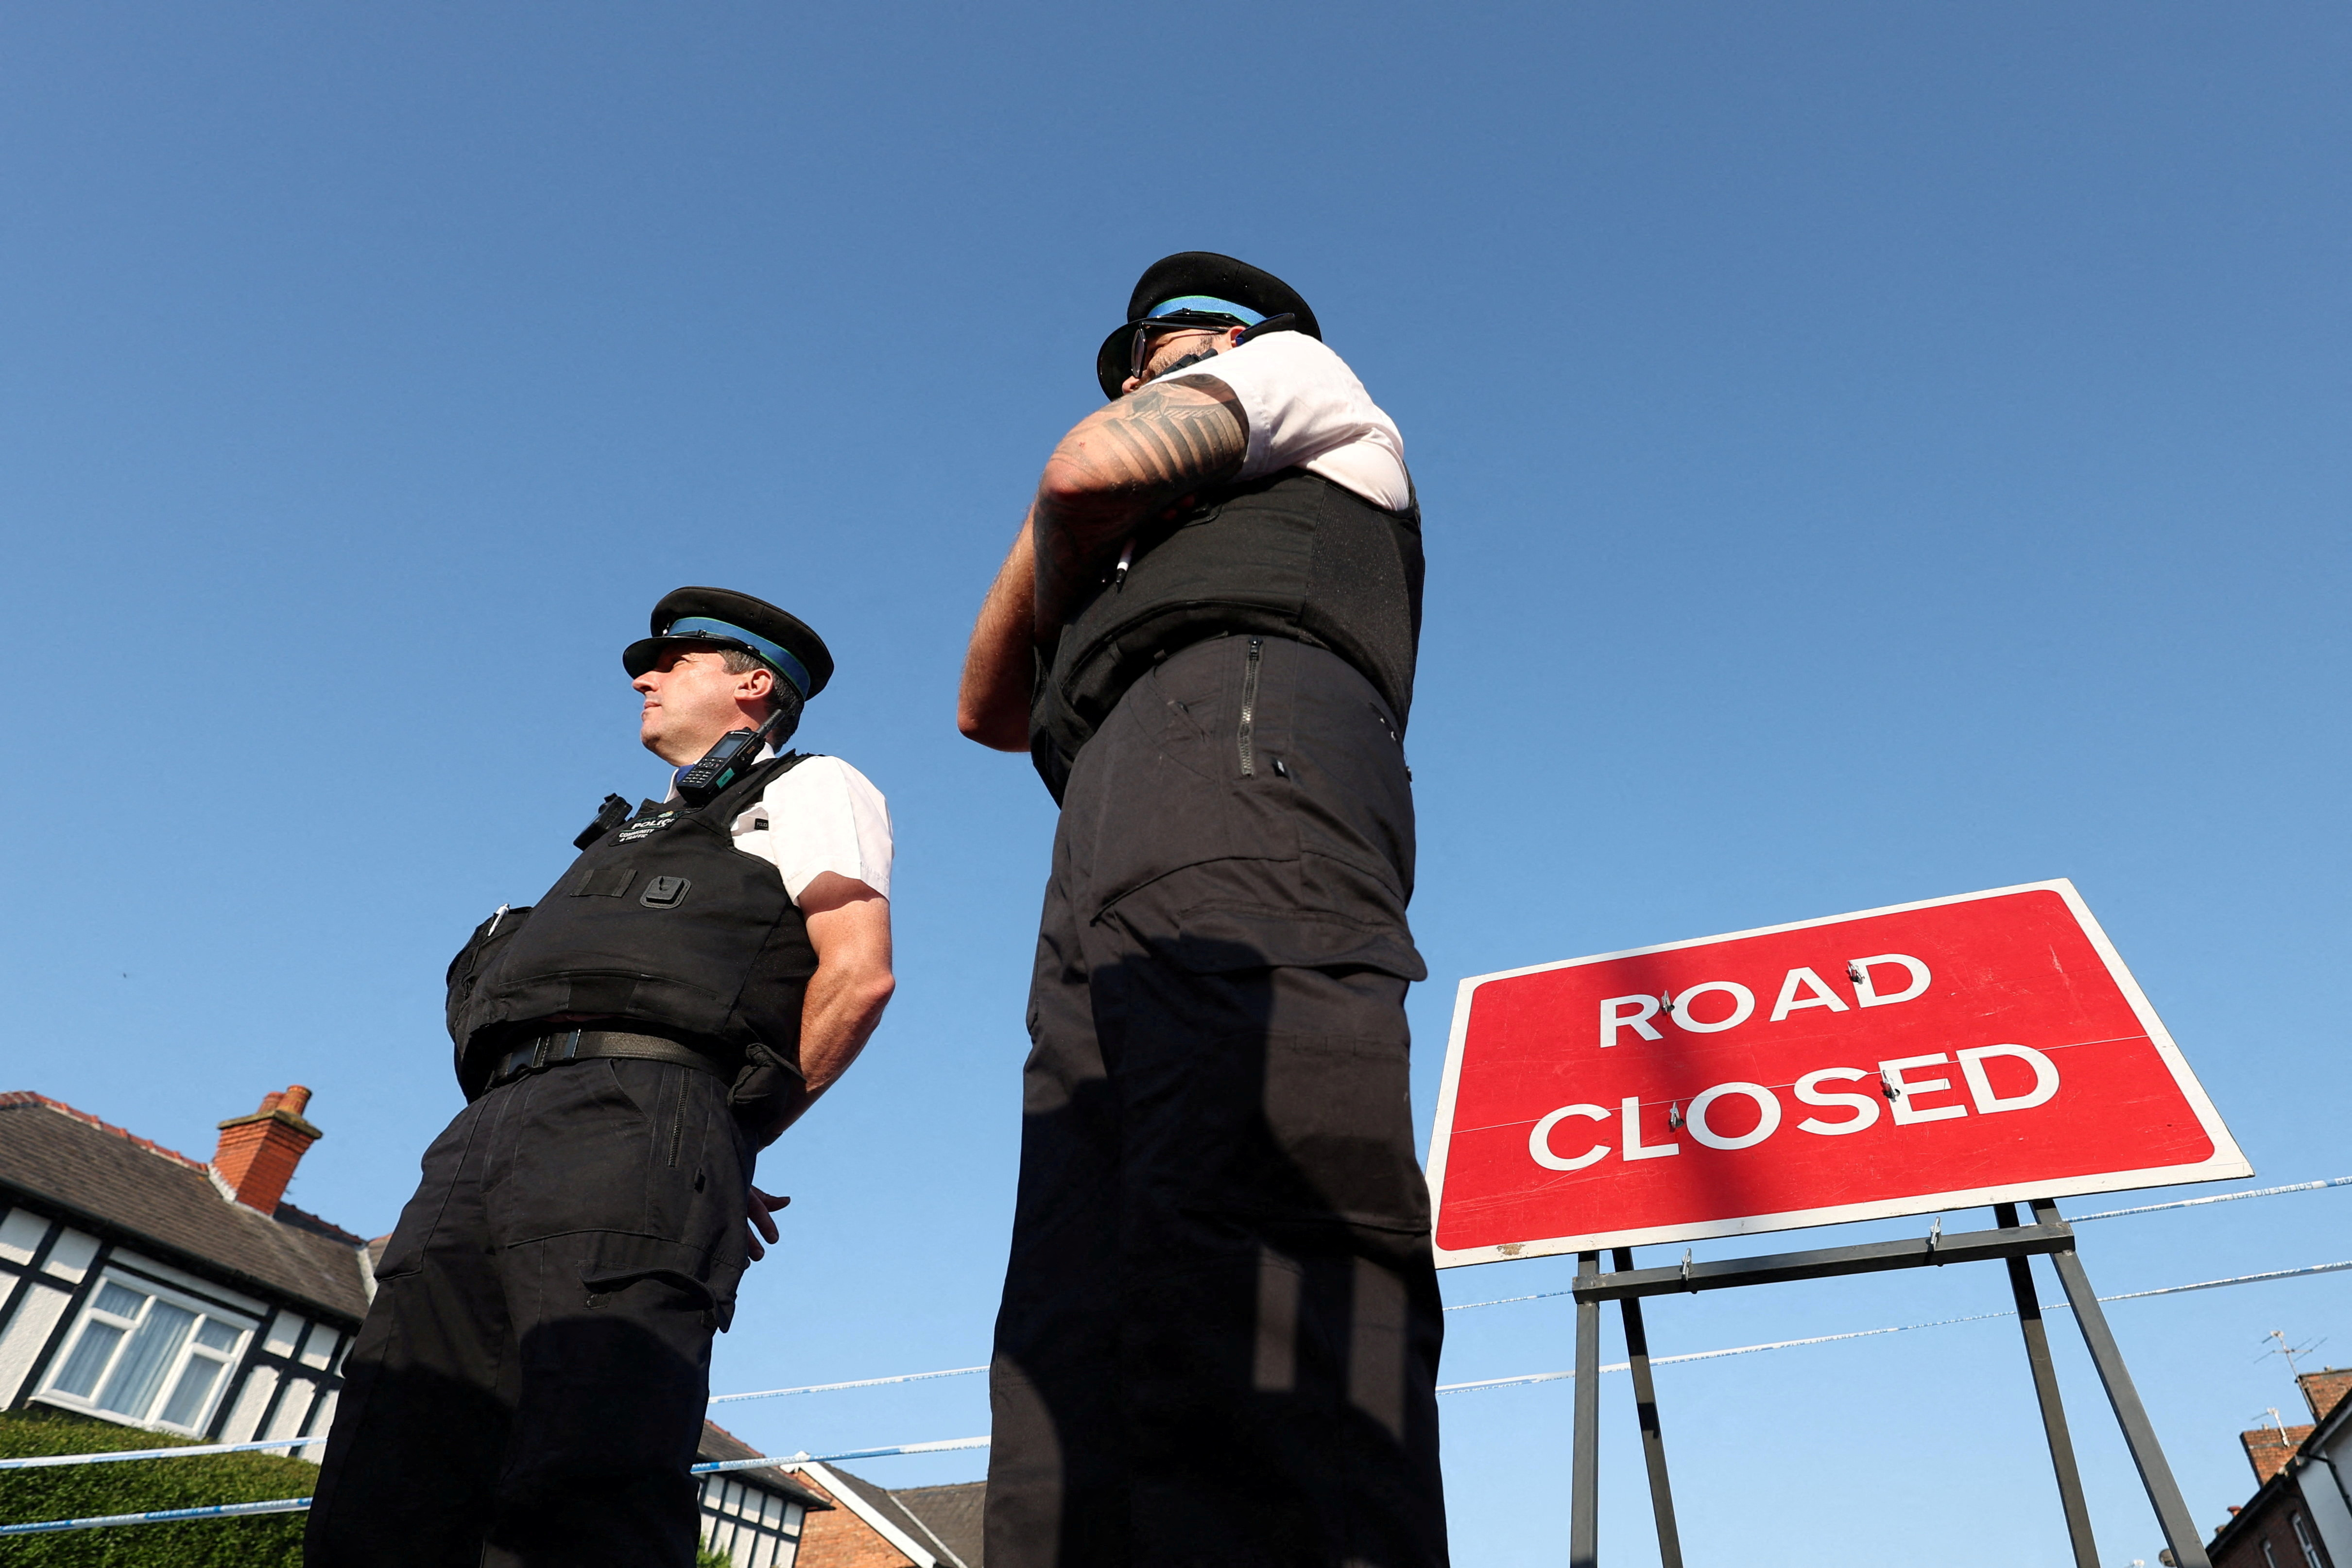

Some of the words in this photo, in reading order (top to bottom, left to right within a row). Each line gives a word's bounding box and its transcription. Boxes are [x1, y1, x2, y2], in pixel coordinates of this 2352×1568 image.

[619, 828, 654, 838] COMMUNITY
[1600, 953, 1931, 1048] ROAD
[1528, 1044, 2060, 1171] CLOSED
